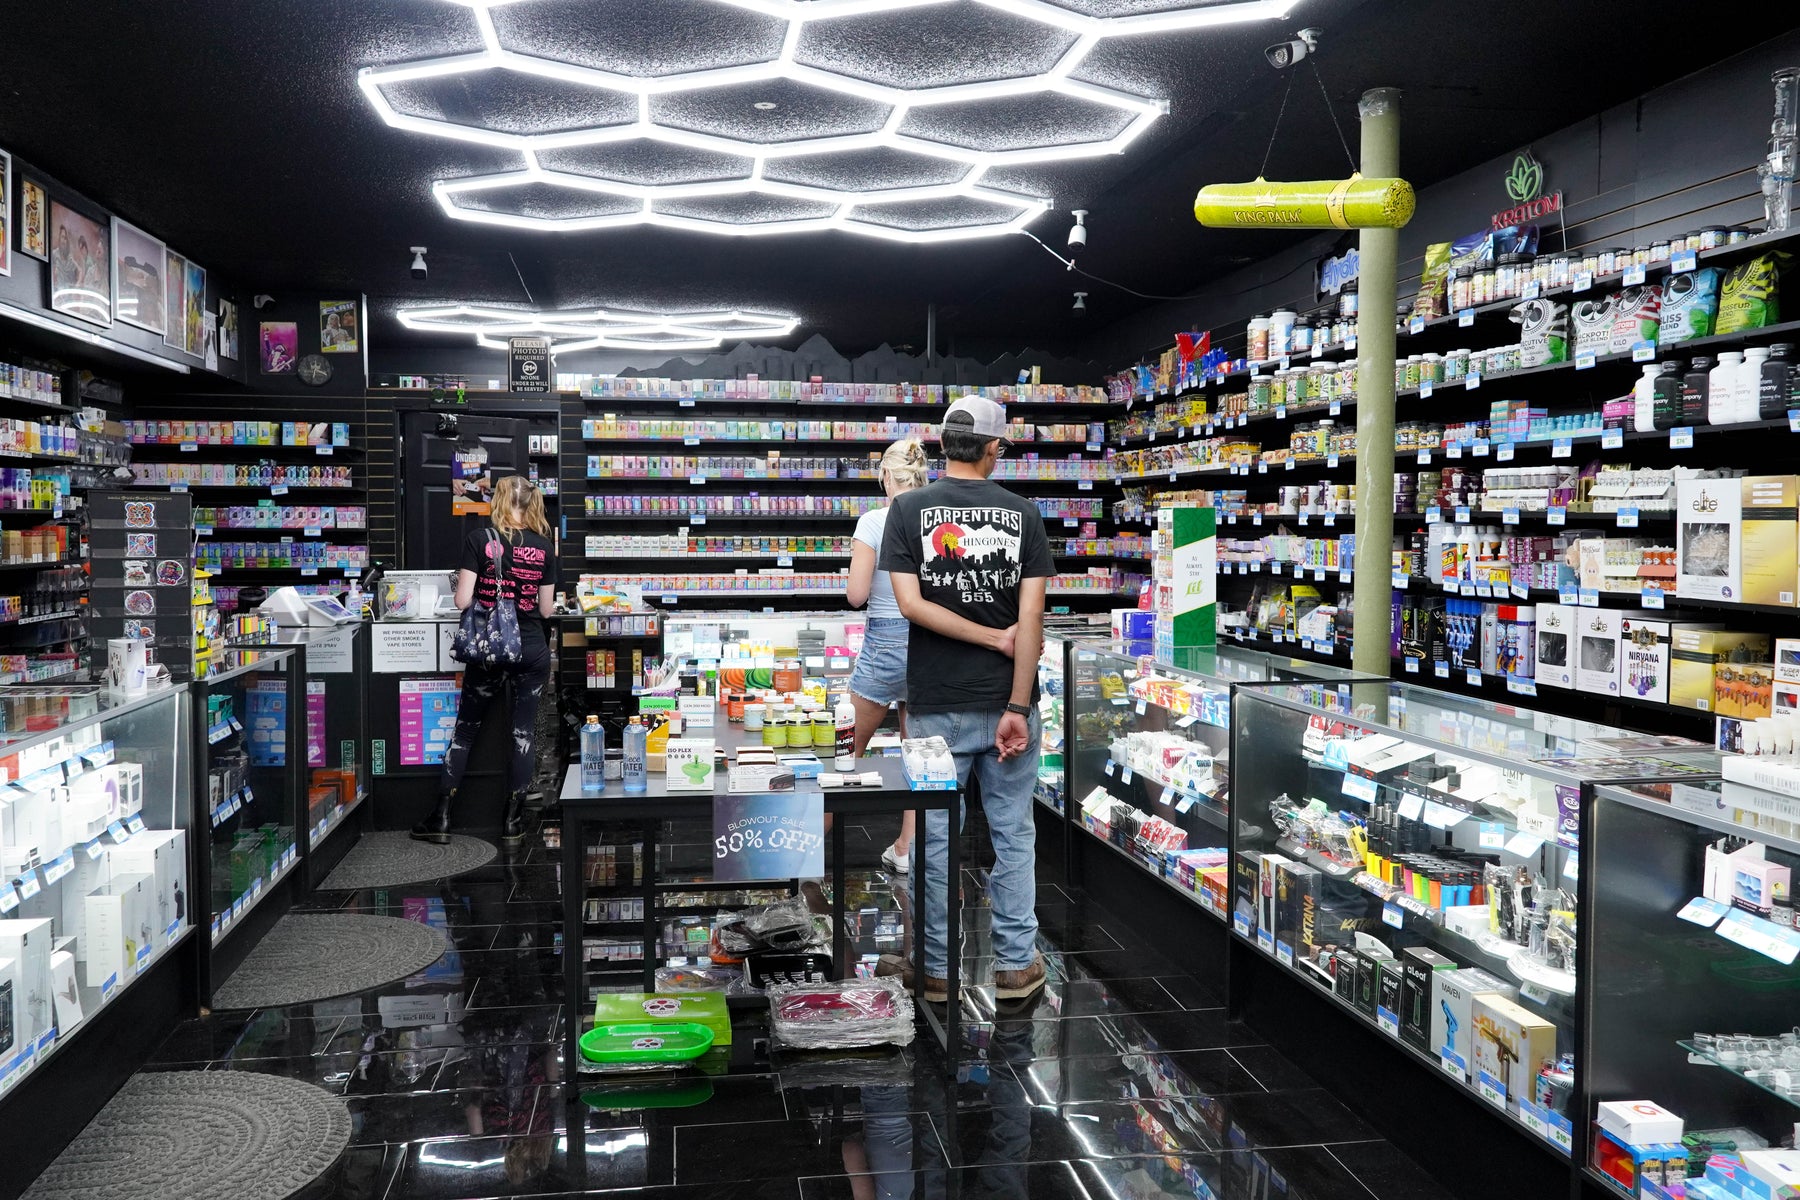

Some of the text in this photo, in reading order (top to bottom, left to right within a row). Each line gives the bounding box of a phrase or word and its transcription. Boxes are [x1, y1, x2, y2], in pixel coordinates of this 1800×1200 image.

[1234, 211, 1299, 223] KING PALM
[1492, 193, 1560, 231] KRATOM
[1321, 253, 1359, 287] Hydr
[455, 451, 476, 462] UNDER
[1693, 488, 1718, 511] elite
[923, 509, 1019, 531] CARPENTERS
[961, 592, 994, 603] 555
[1629, 651, 1659, 663] NIRVANA
[1502, 768, 1524, 781] LIMIT
[727, 815, 806, 831] BLOWOUT SALE
[1526, 817, 1542, 828] LIMIT
[715, 828, 823, 858] 50% OFF!
[1302, 895, 1315, 946] KATANA
[1407, 966, 1427, 982] aLeaf
[1383, 977, 1398, 989] aLeaf
[1441, 982, 1461, 1000] MAVEN
